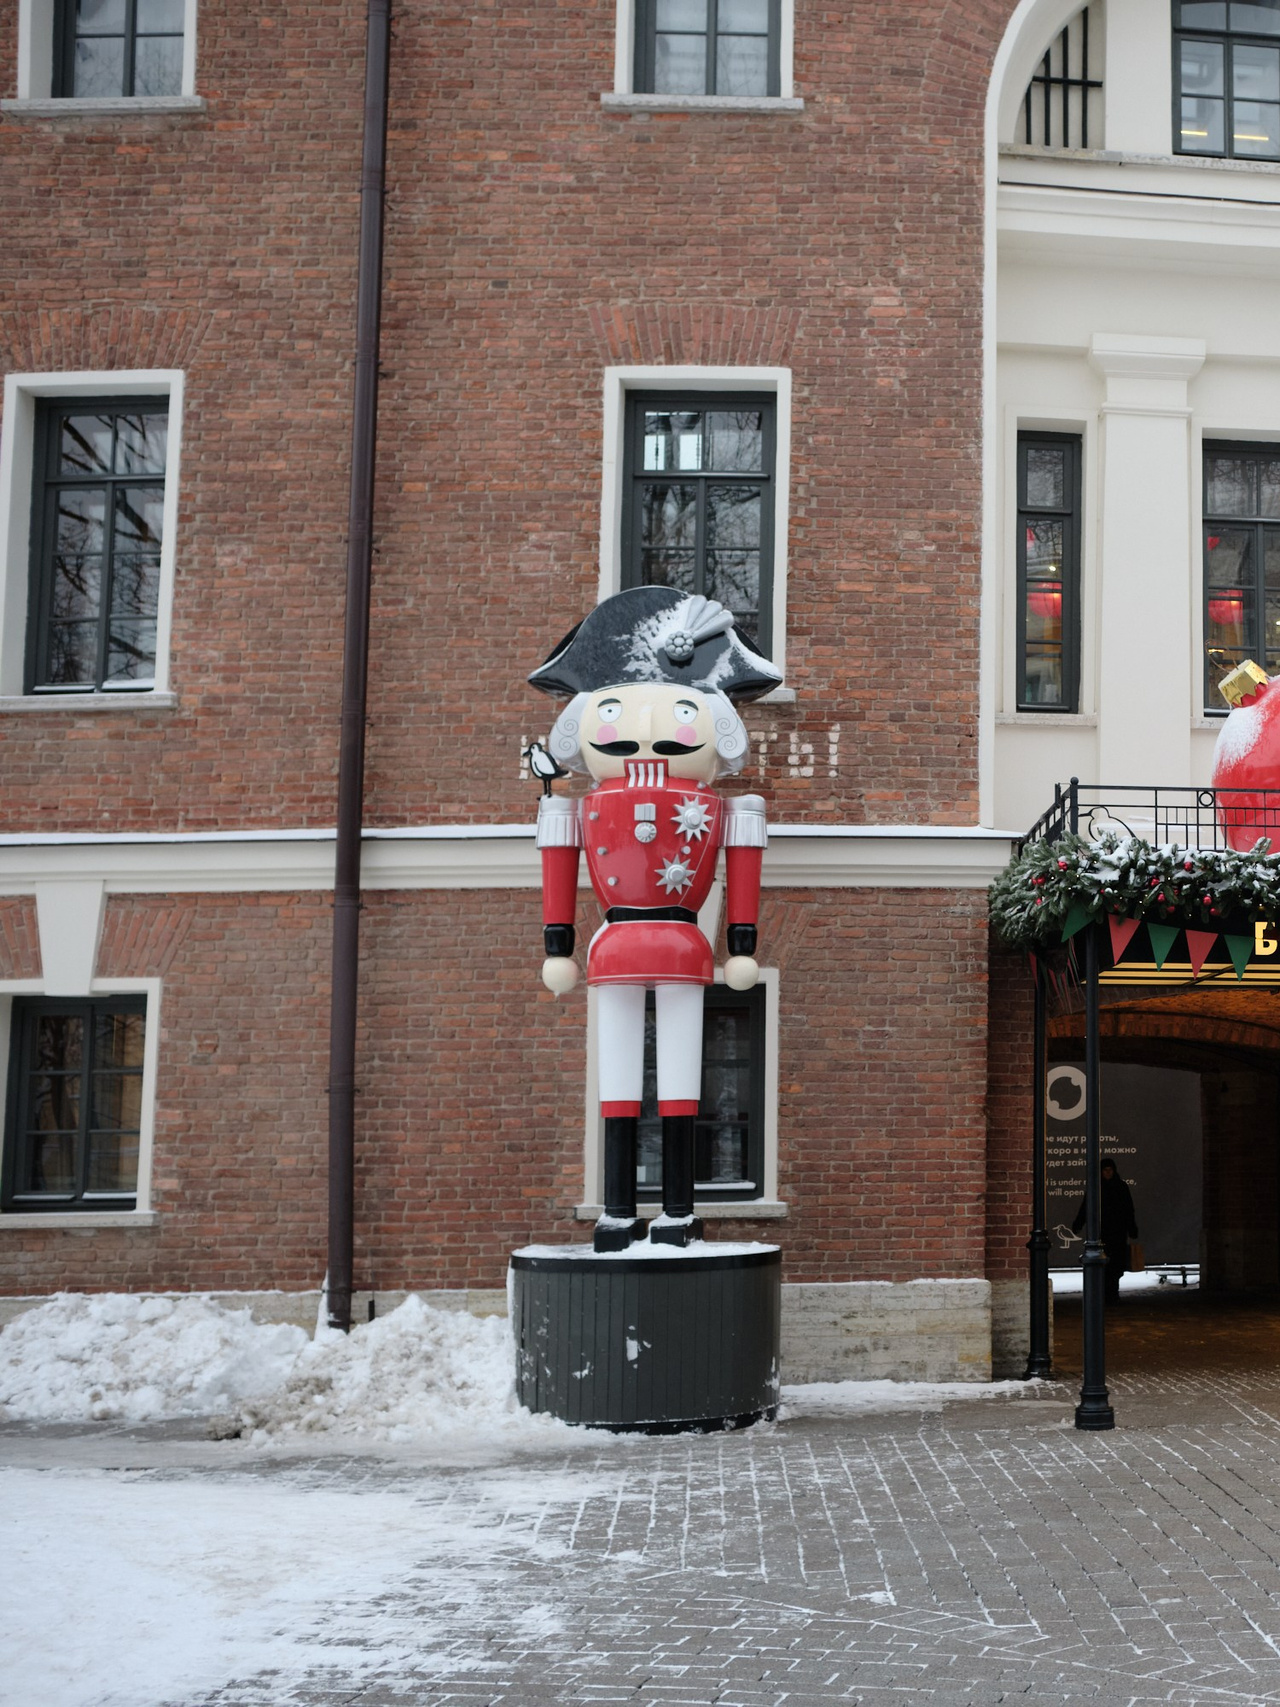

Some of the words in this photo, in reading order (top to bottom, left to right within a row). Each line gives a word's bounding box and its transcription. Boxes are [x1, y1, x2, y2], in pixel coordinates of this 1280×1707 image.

[1056, 1135, 1078, 1144] идут
[1080, 1135, 1117, 1144] роты,
[1047, 1148, 1071, 1156] коро
[1050, 1178, 1057, 1186] is
[1058, 1177, 1082, 1186] under
[1048, 1188, 1062, 1196] will
[1064, 1190, 1085, 1198] open
